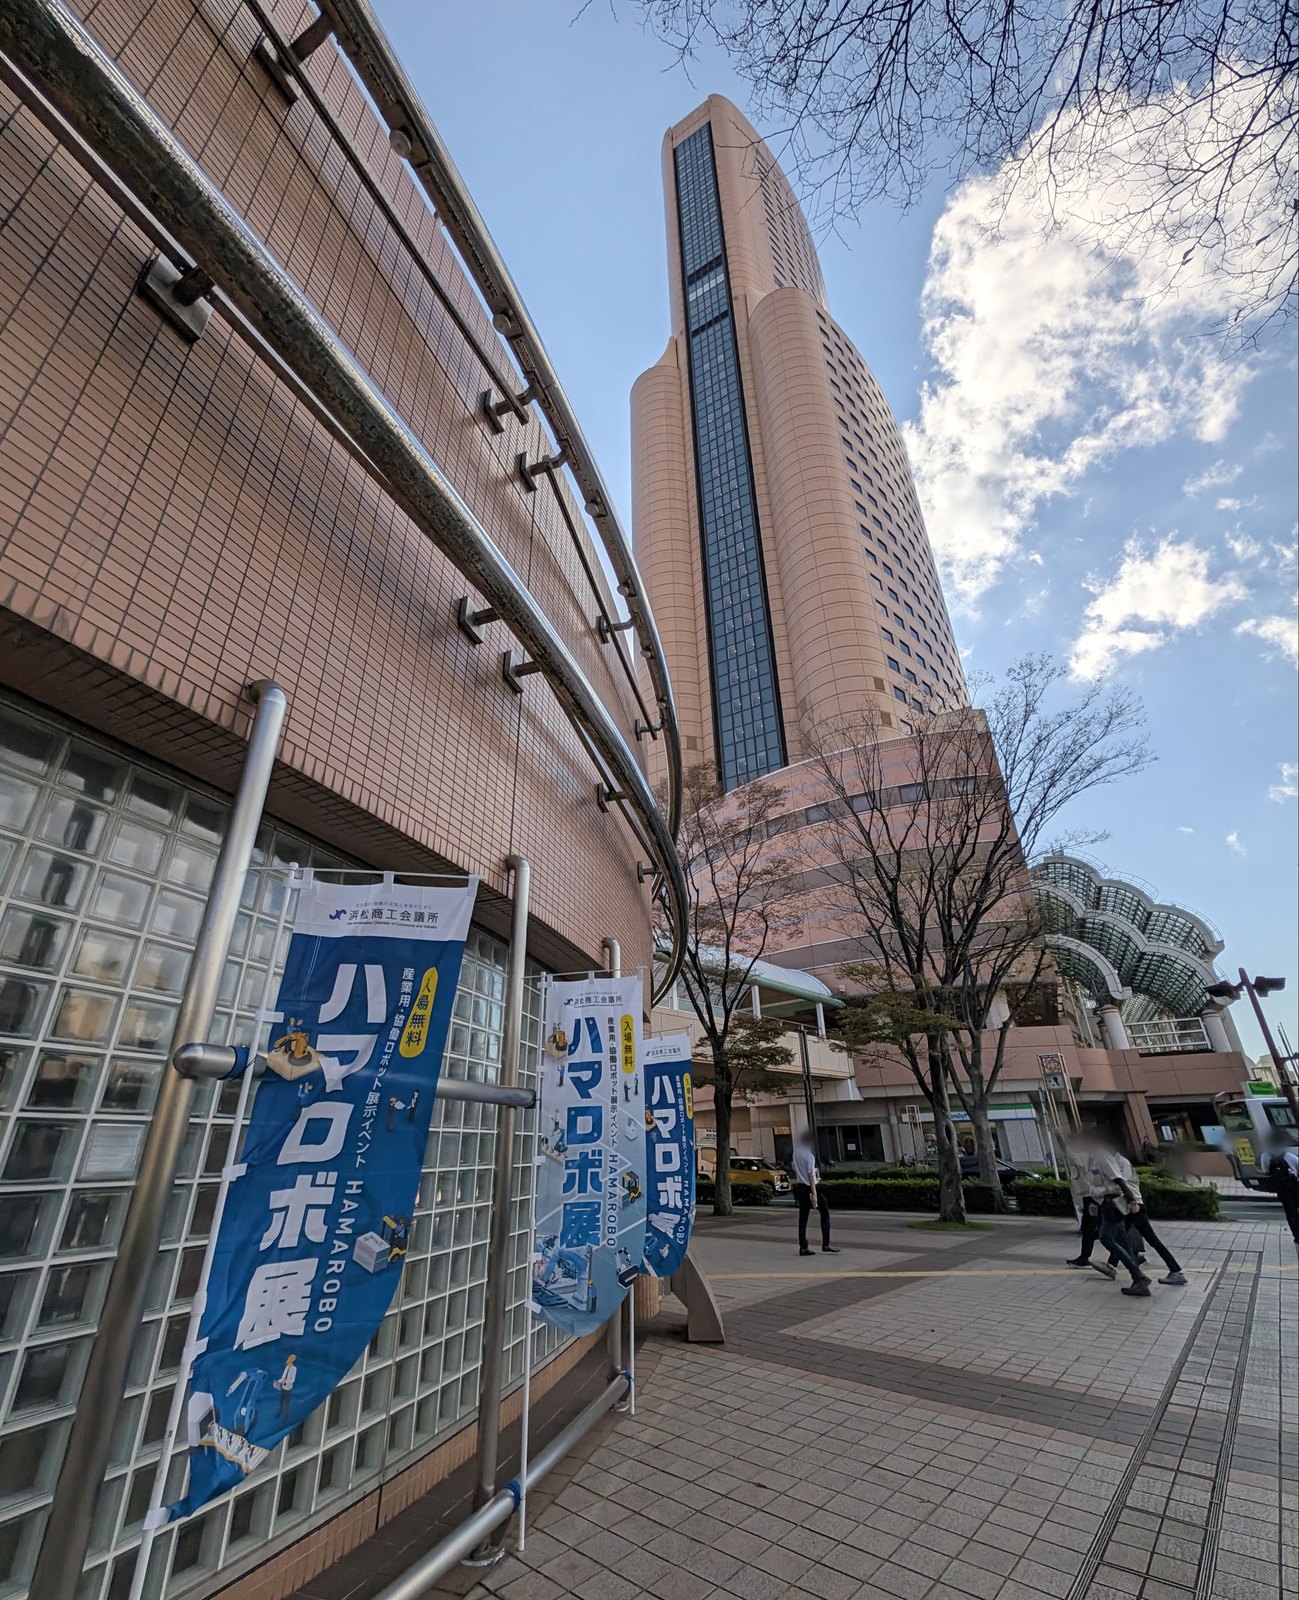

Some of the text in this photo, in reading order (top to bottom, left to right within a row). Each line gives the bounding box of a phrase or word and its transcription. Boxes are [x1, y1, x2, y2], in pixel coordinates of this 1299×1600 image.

[348, 908, 439, 924] 浜松商工会議所
[405, 978, 431, 1047] 入場無料
[624, 1021, 634, 1067] 入場無料
[234, 963, 387, 1350] ハマロボ展
[560, 1017, 603, 1249] ハマロボ展
[606, 1154, 618, 1247] HAMAROBO
[313, 1180, 364, 1332] HAMAROBO
